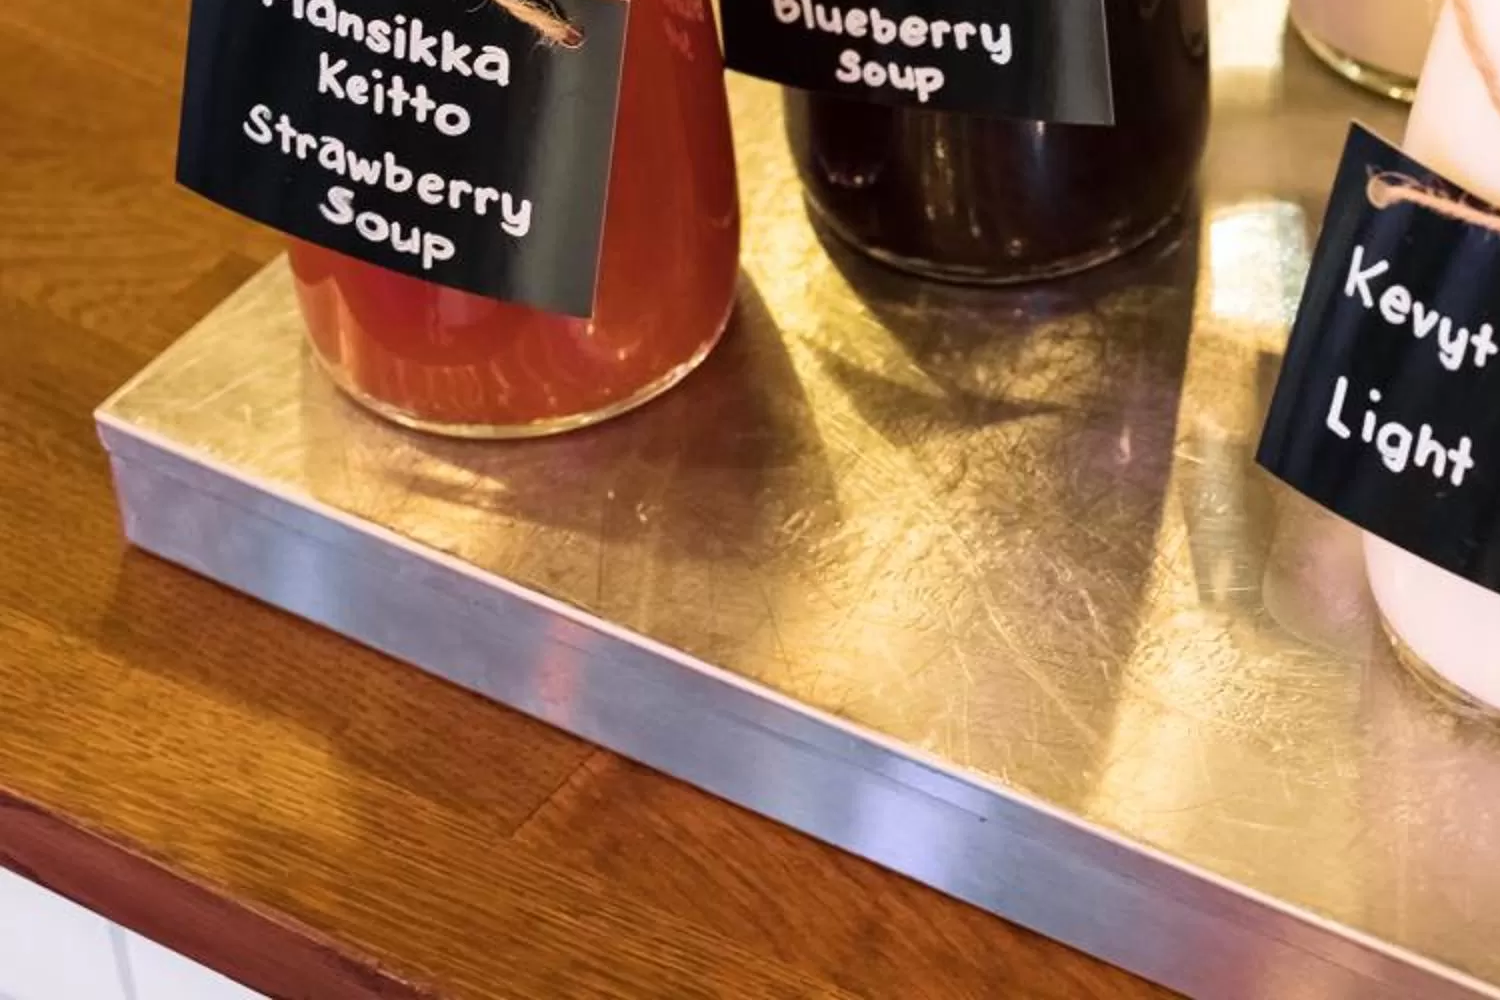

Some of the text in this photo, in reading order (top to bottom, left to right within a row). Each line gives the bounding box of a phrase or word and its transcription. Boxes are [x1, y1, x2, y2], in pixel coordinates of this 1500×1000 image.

[317, 53, 472, 137] Keitto
[834, 49, 945, 103] Soup
[242, 104, 533, 238] Strawberry
[318, 185, 456, 269] Soup
[1344, 245, 1500, 372] Kevyt
[1325, 375, 1476, 487] Light
